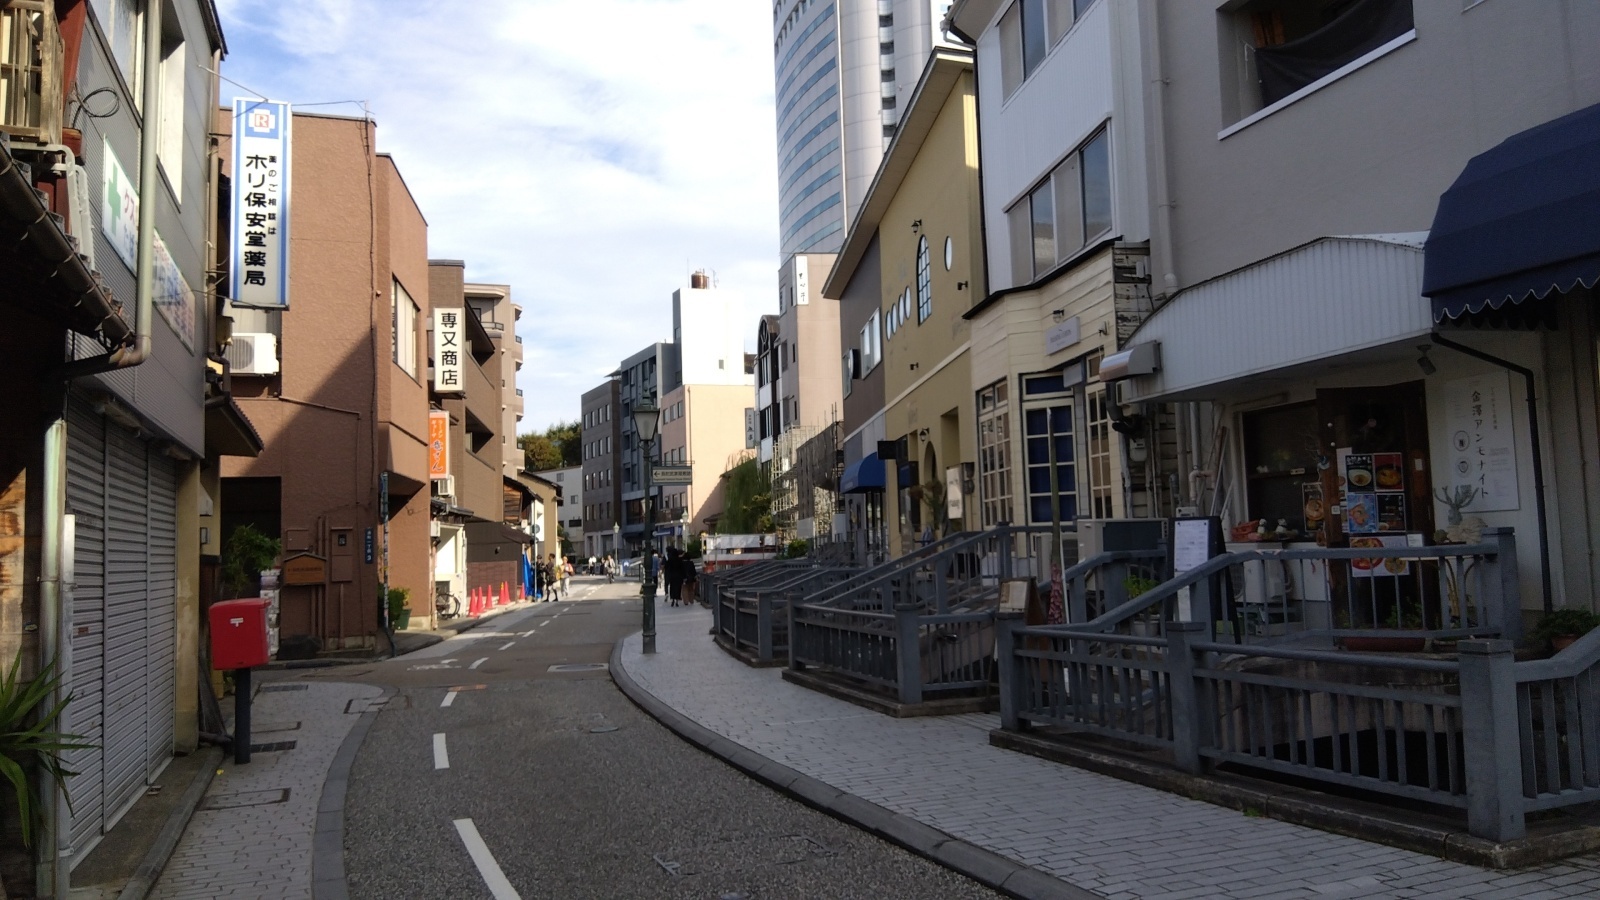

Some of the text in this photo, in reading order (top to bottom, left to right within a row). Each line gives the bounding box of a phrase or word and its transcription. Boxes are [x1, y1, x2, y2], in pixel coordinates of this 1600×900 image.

[244, 154, 268, 286] ホリ保安堂薬局
[441, 312, 458, 386] 専又商店
[1471, 390, 1489, 499] 金澤アンモナイト
